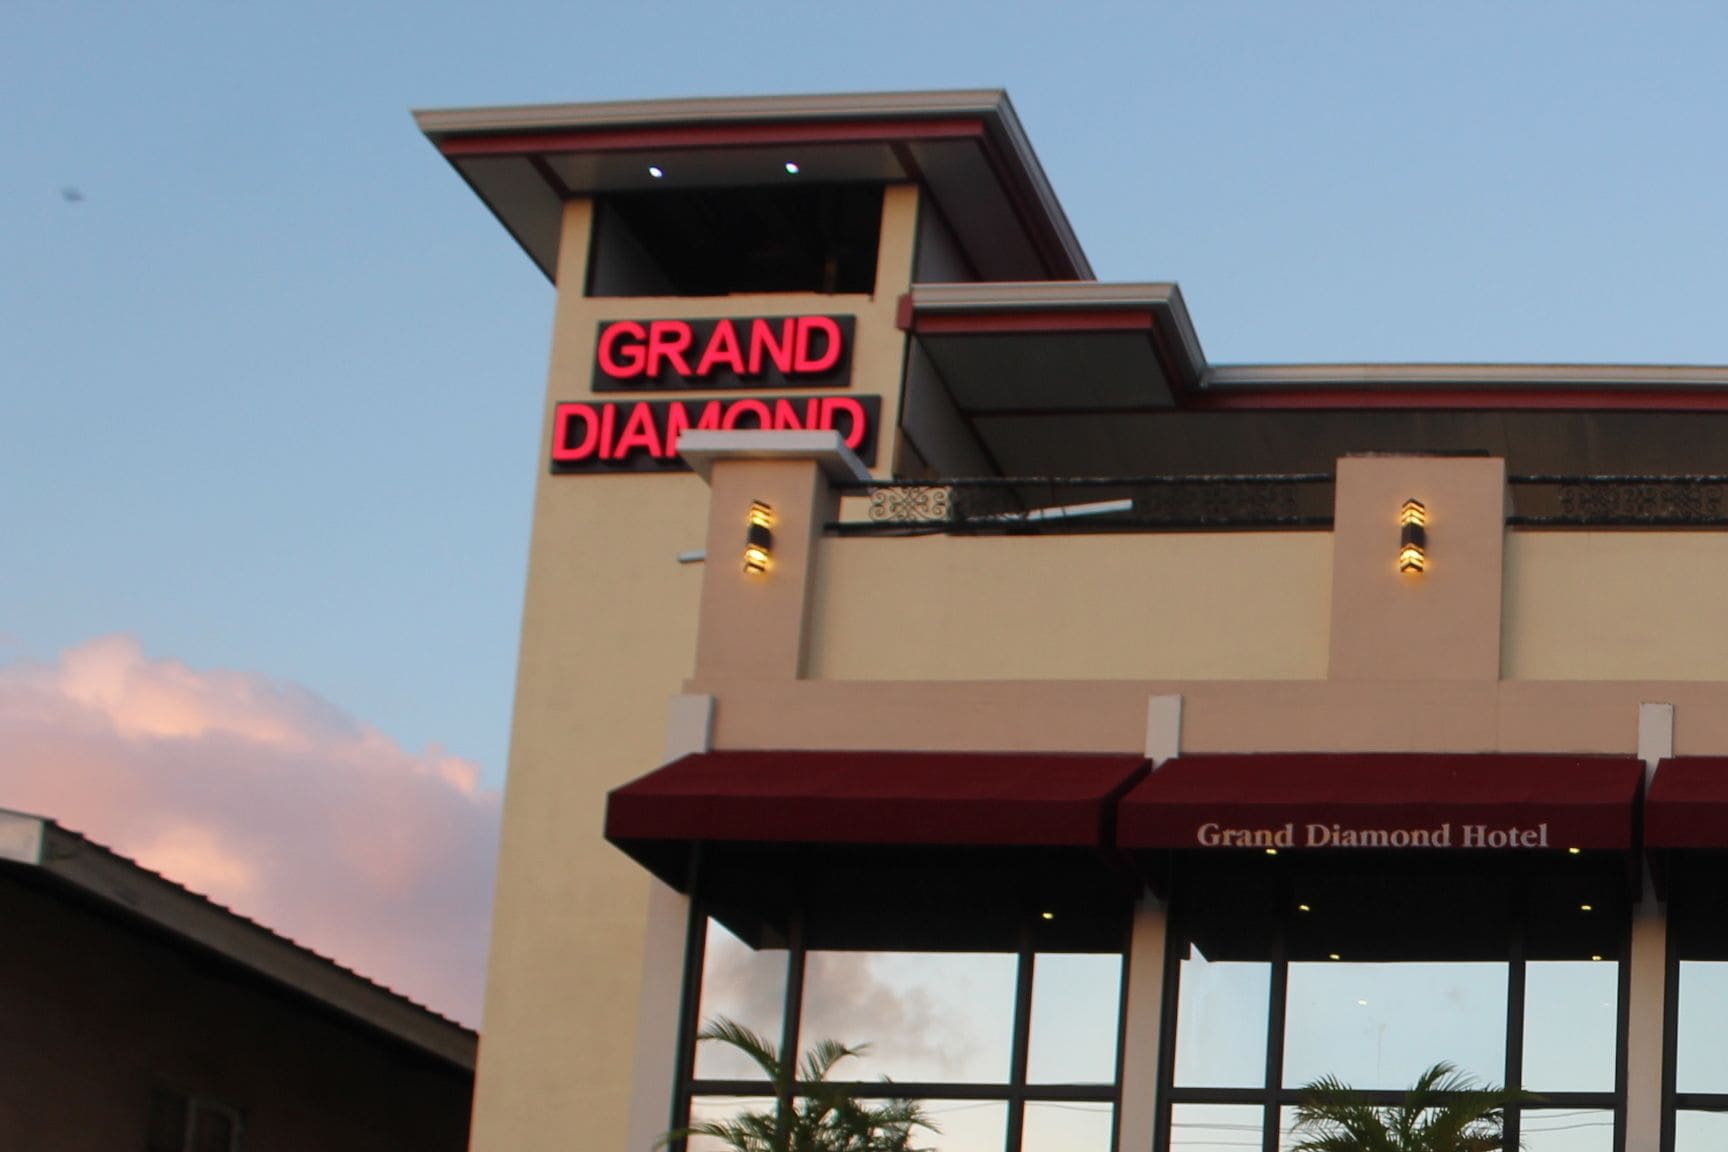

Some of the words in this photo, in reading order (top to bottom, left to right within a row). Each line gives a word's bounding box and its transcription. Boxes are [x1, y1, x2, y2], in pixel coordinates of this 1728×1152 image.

[598, 315, 843, 378] GRAND
[1196, 822, 1294, 848] Grand
[1304, 823, 1452, 848] Diamond
[1460, 823, 1549, 848] Hotel
